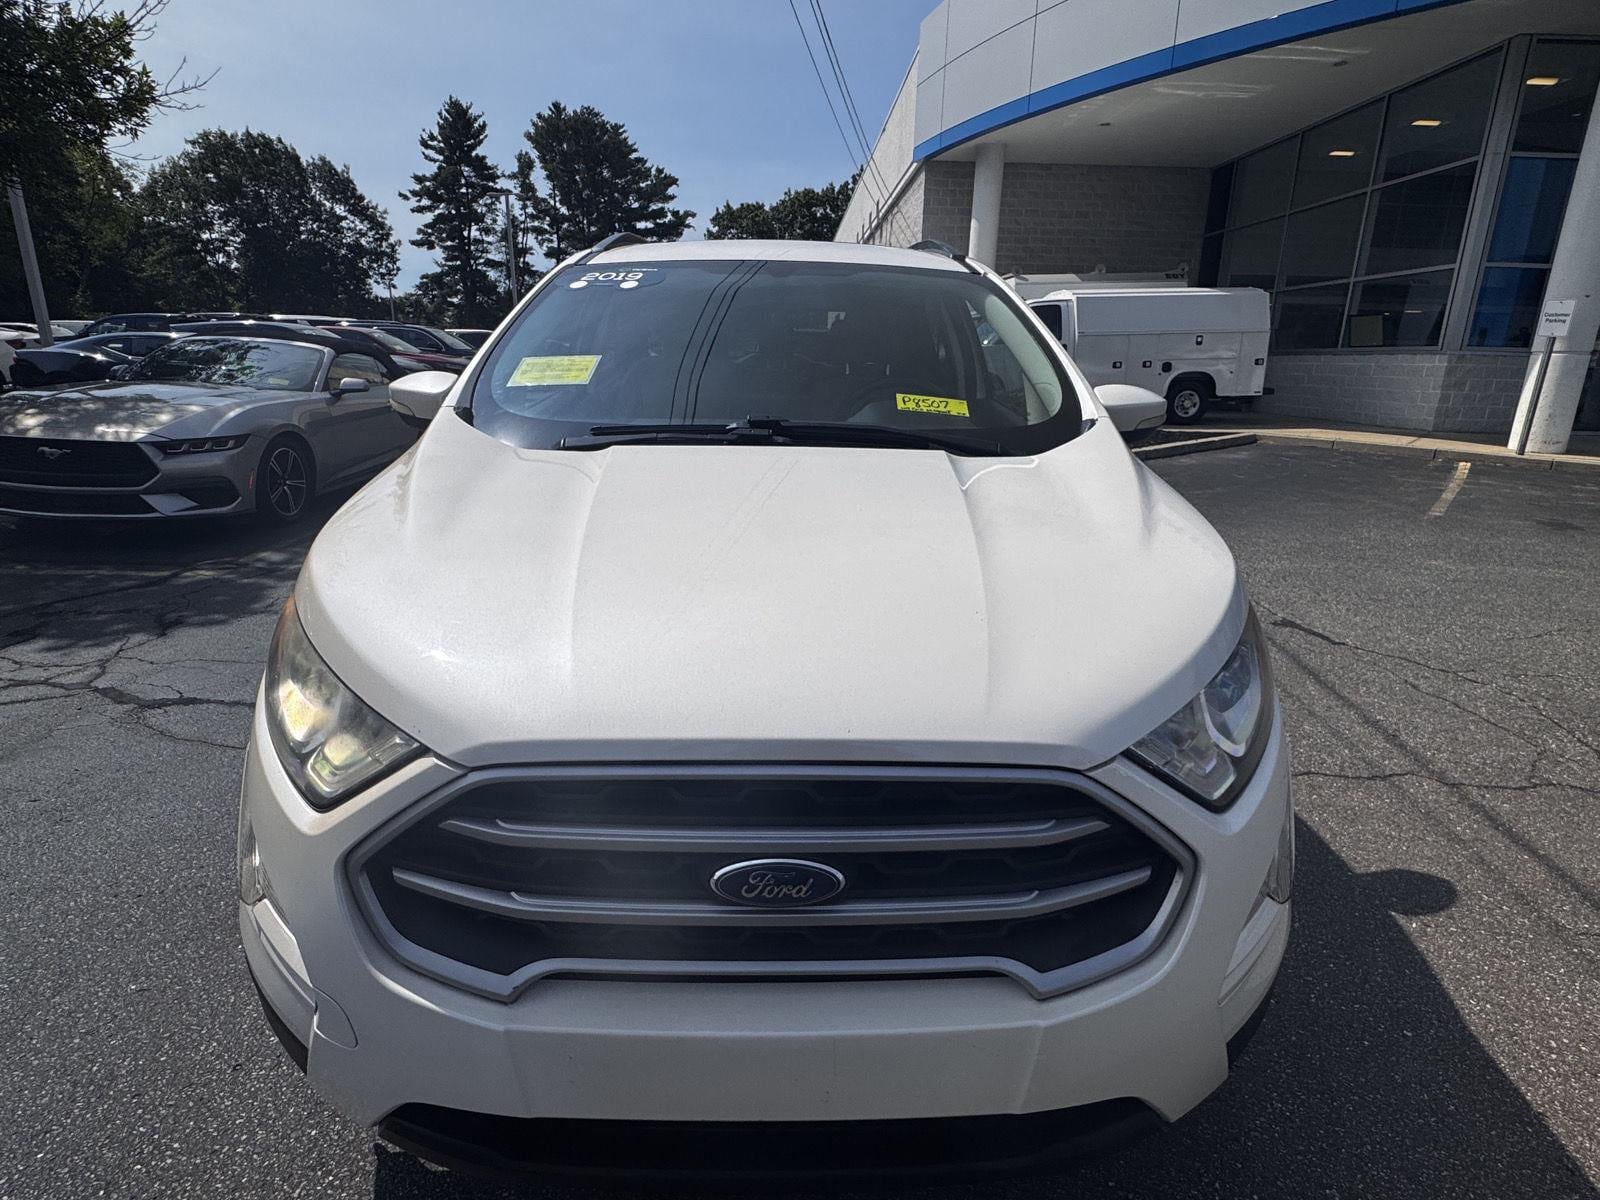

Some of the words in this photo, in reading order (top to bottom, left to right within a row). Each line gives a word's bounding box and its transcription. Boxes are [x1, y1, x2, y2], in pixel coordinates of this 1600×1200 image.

[580, 272, 644, 281] 2019
[901, 395, 949, 409] P8507
[741, 870, 814, 898] Ford
